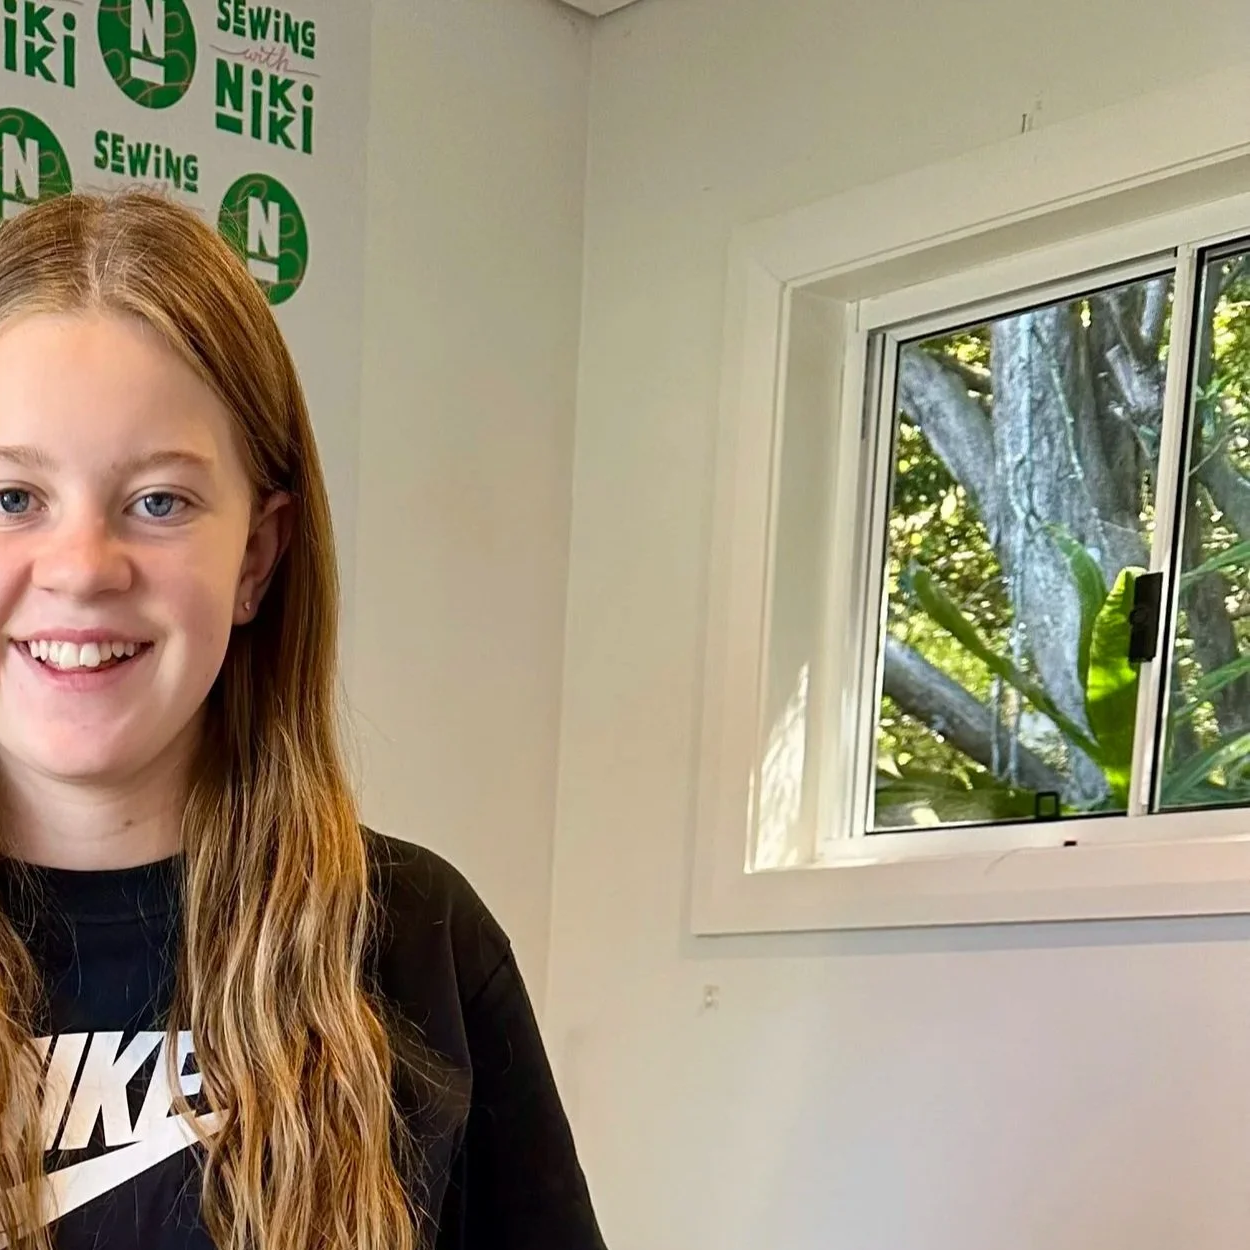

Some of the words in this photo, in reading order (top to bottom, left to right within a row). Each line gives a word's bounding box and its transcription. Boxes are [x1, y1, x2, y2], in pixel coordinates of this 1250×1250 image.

[129, 0, 166, 84] N
[209, 44, 321, 77] with
[1, 132, 40, 201] N
[246, 195, 280, 282] N
[22, 1030, 205, 1151] IKE
